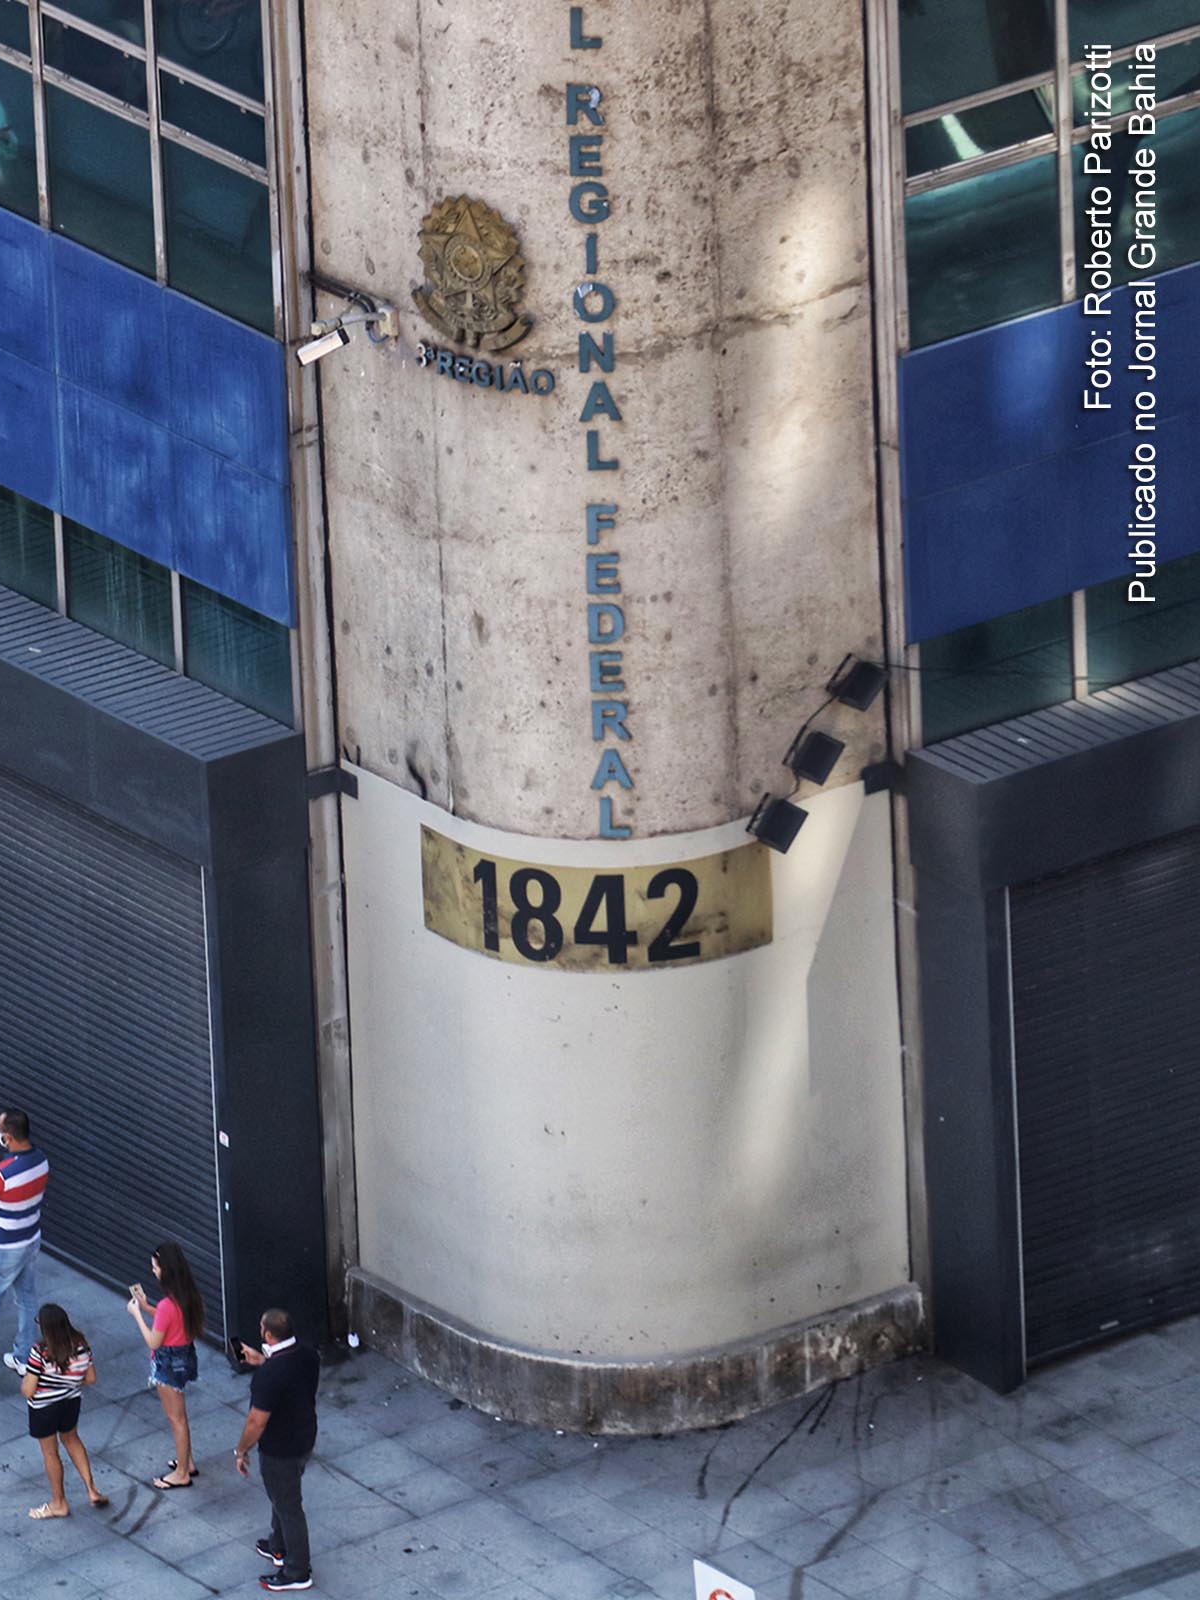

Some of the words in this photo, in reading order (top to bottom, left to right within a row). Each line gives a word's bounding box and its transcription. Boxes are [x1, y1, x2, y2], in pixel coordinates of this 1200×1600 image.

[436, 350, 556, 397] REGIÃO
[565, 82, 623, 472] REGIONAL
[584, 502, 635, 840] FEDERAL
[473, 857, 701, 965] 1842
